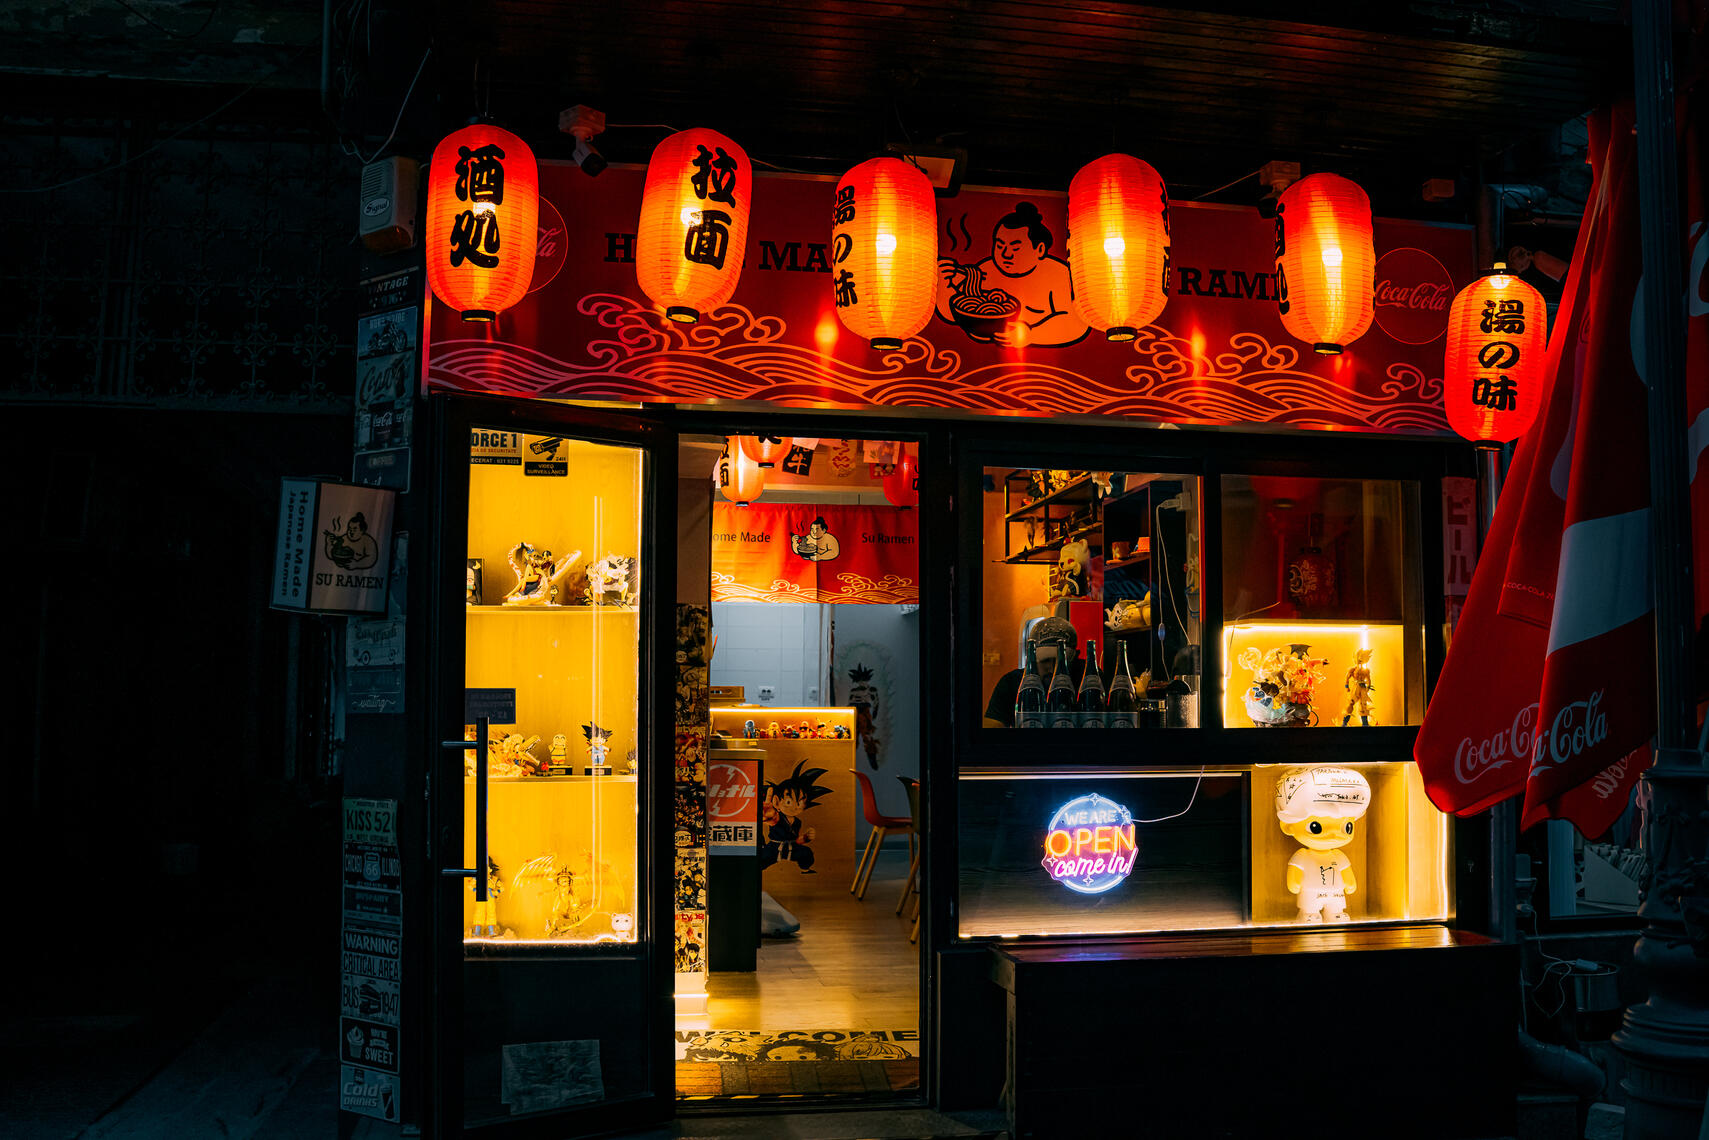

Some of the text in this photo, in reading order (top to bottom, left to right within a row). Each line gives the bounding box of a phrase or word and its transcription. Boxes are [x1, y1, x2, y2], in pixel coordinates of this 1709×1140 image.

[684, 144, 738, 270] 拉面
[759, 240, 833, 273] MA
[1177, 267, 1280, 301] RAM
[1472, 299, 1526, 411] 湯の味
[472, 432, 508, 448] ORCE
[292, 490, 309, 597] Home Made
[712, 531, 771, 543] ome Made
[862, 532, 916, 544] Su Ramen
[281, 553, 291, 596] Ramen
[315, 573, 385, 589] SU RAMEN
[346, 808, 391, 833] KISS 52
[1065, 809, 1117, 825] WE ARE
[1048, 825, 1135, 857] OPEN
[366, 863, 378, 876] 66
[1055, 857, 1106, 878] come
[345, 933, 398, 955] WARNING
[343, 953, 399, 978] CRITICAL AREA
[344, 984, 360, 1009] BUS
[365, 1046, 394, 1065] SWEET
